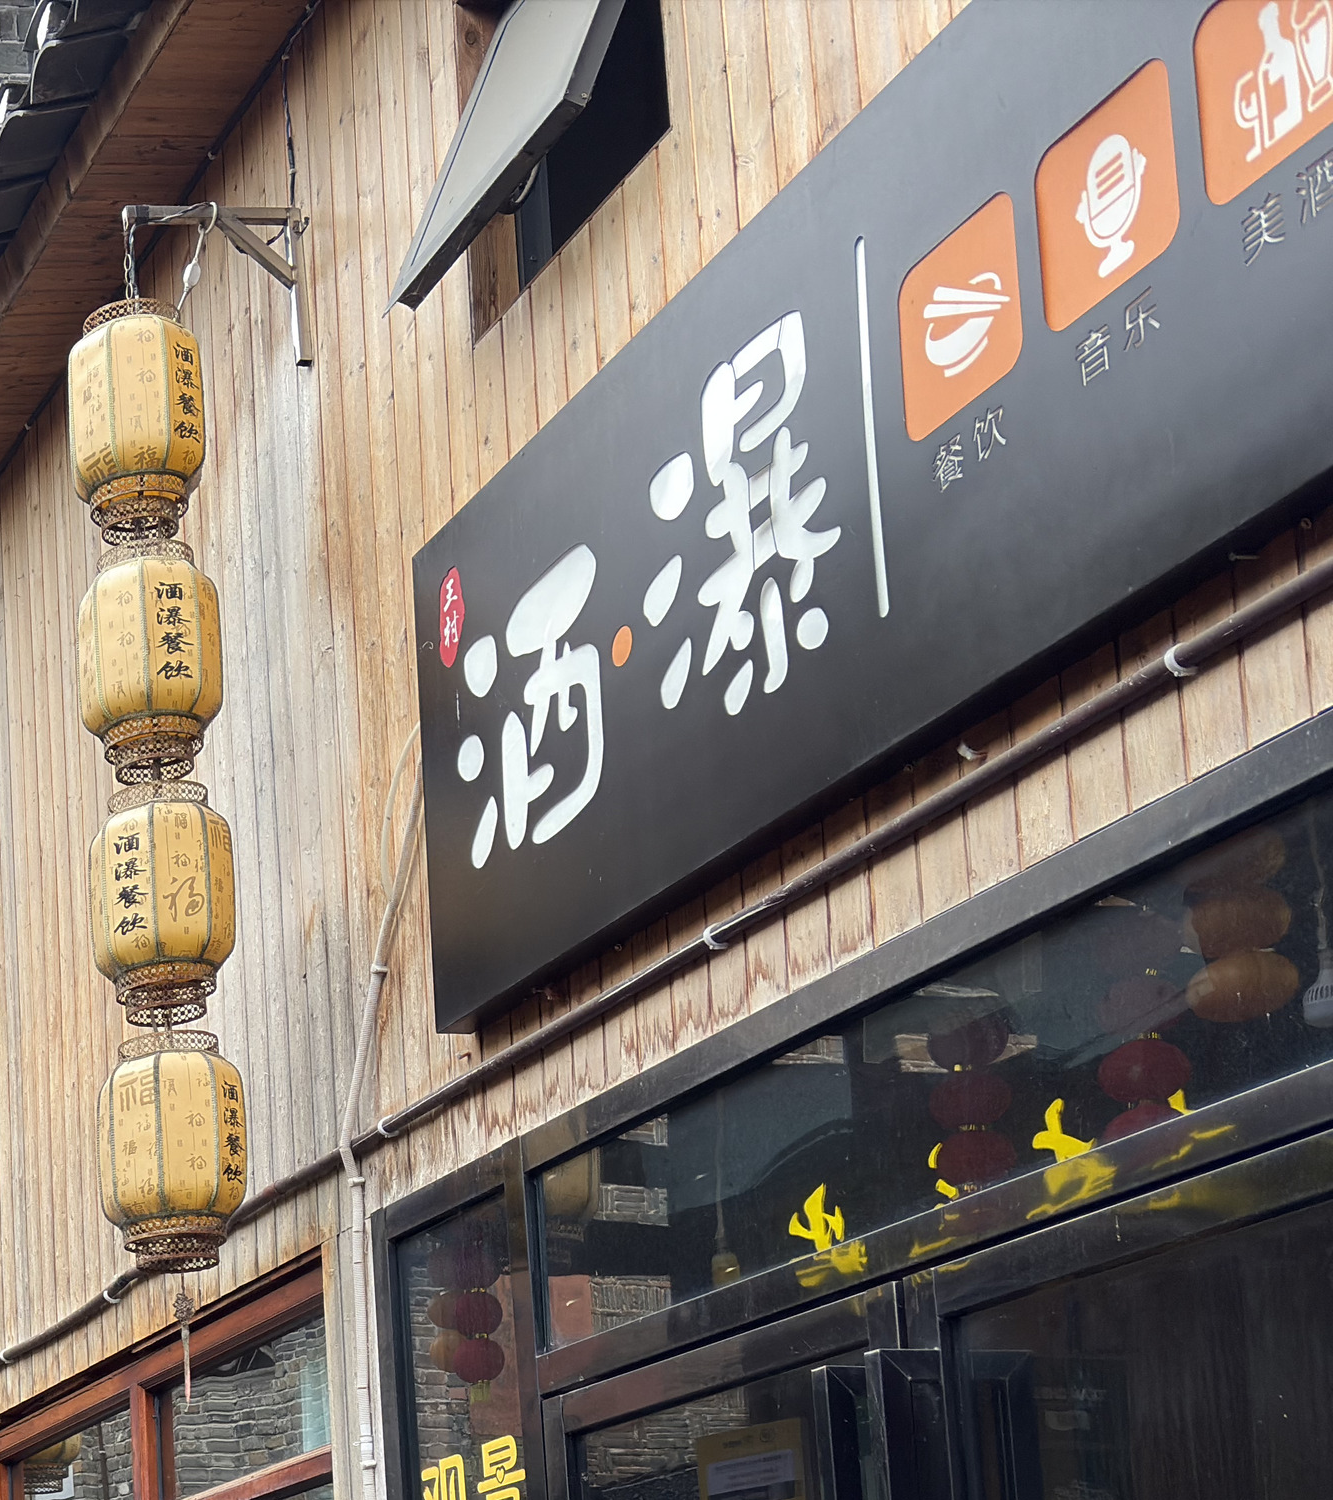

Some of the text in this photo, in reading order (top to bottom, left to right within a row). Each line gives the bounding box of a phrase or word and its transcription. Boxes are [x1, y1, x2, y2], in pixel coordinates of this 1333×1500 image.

[1075, 286, 1161, 387] 音乐
[173, 341, 201, 444] 酒瀑餐饮
[932, 406, 1007, 492] 餐饮
[154, 581, 195, 680] 酒瀑餐饮
[113, 832, 150, 936] 酒瀑餐饮
[221, 1080, 246, 1185] 酒瀑餐饮
